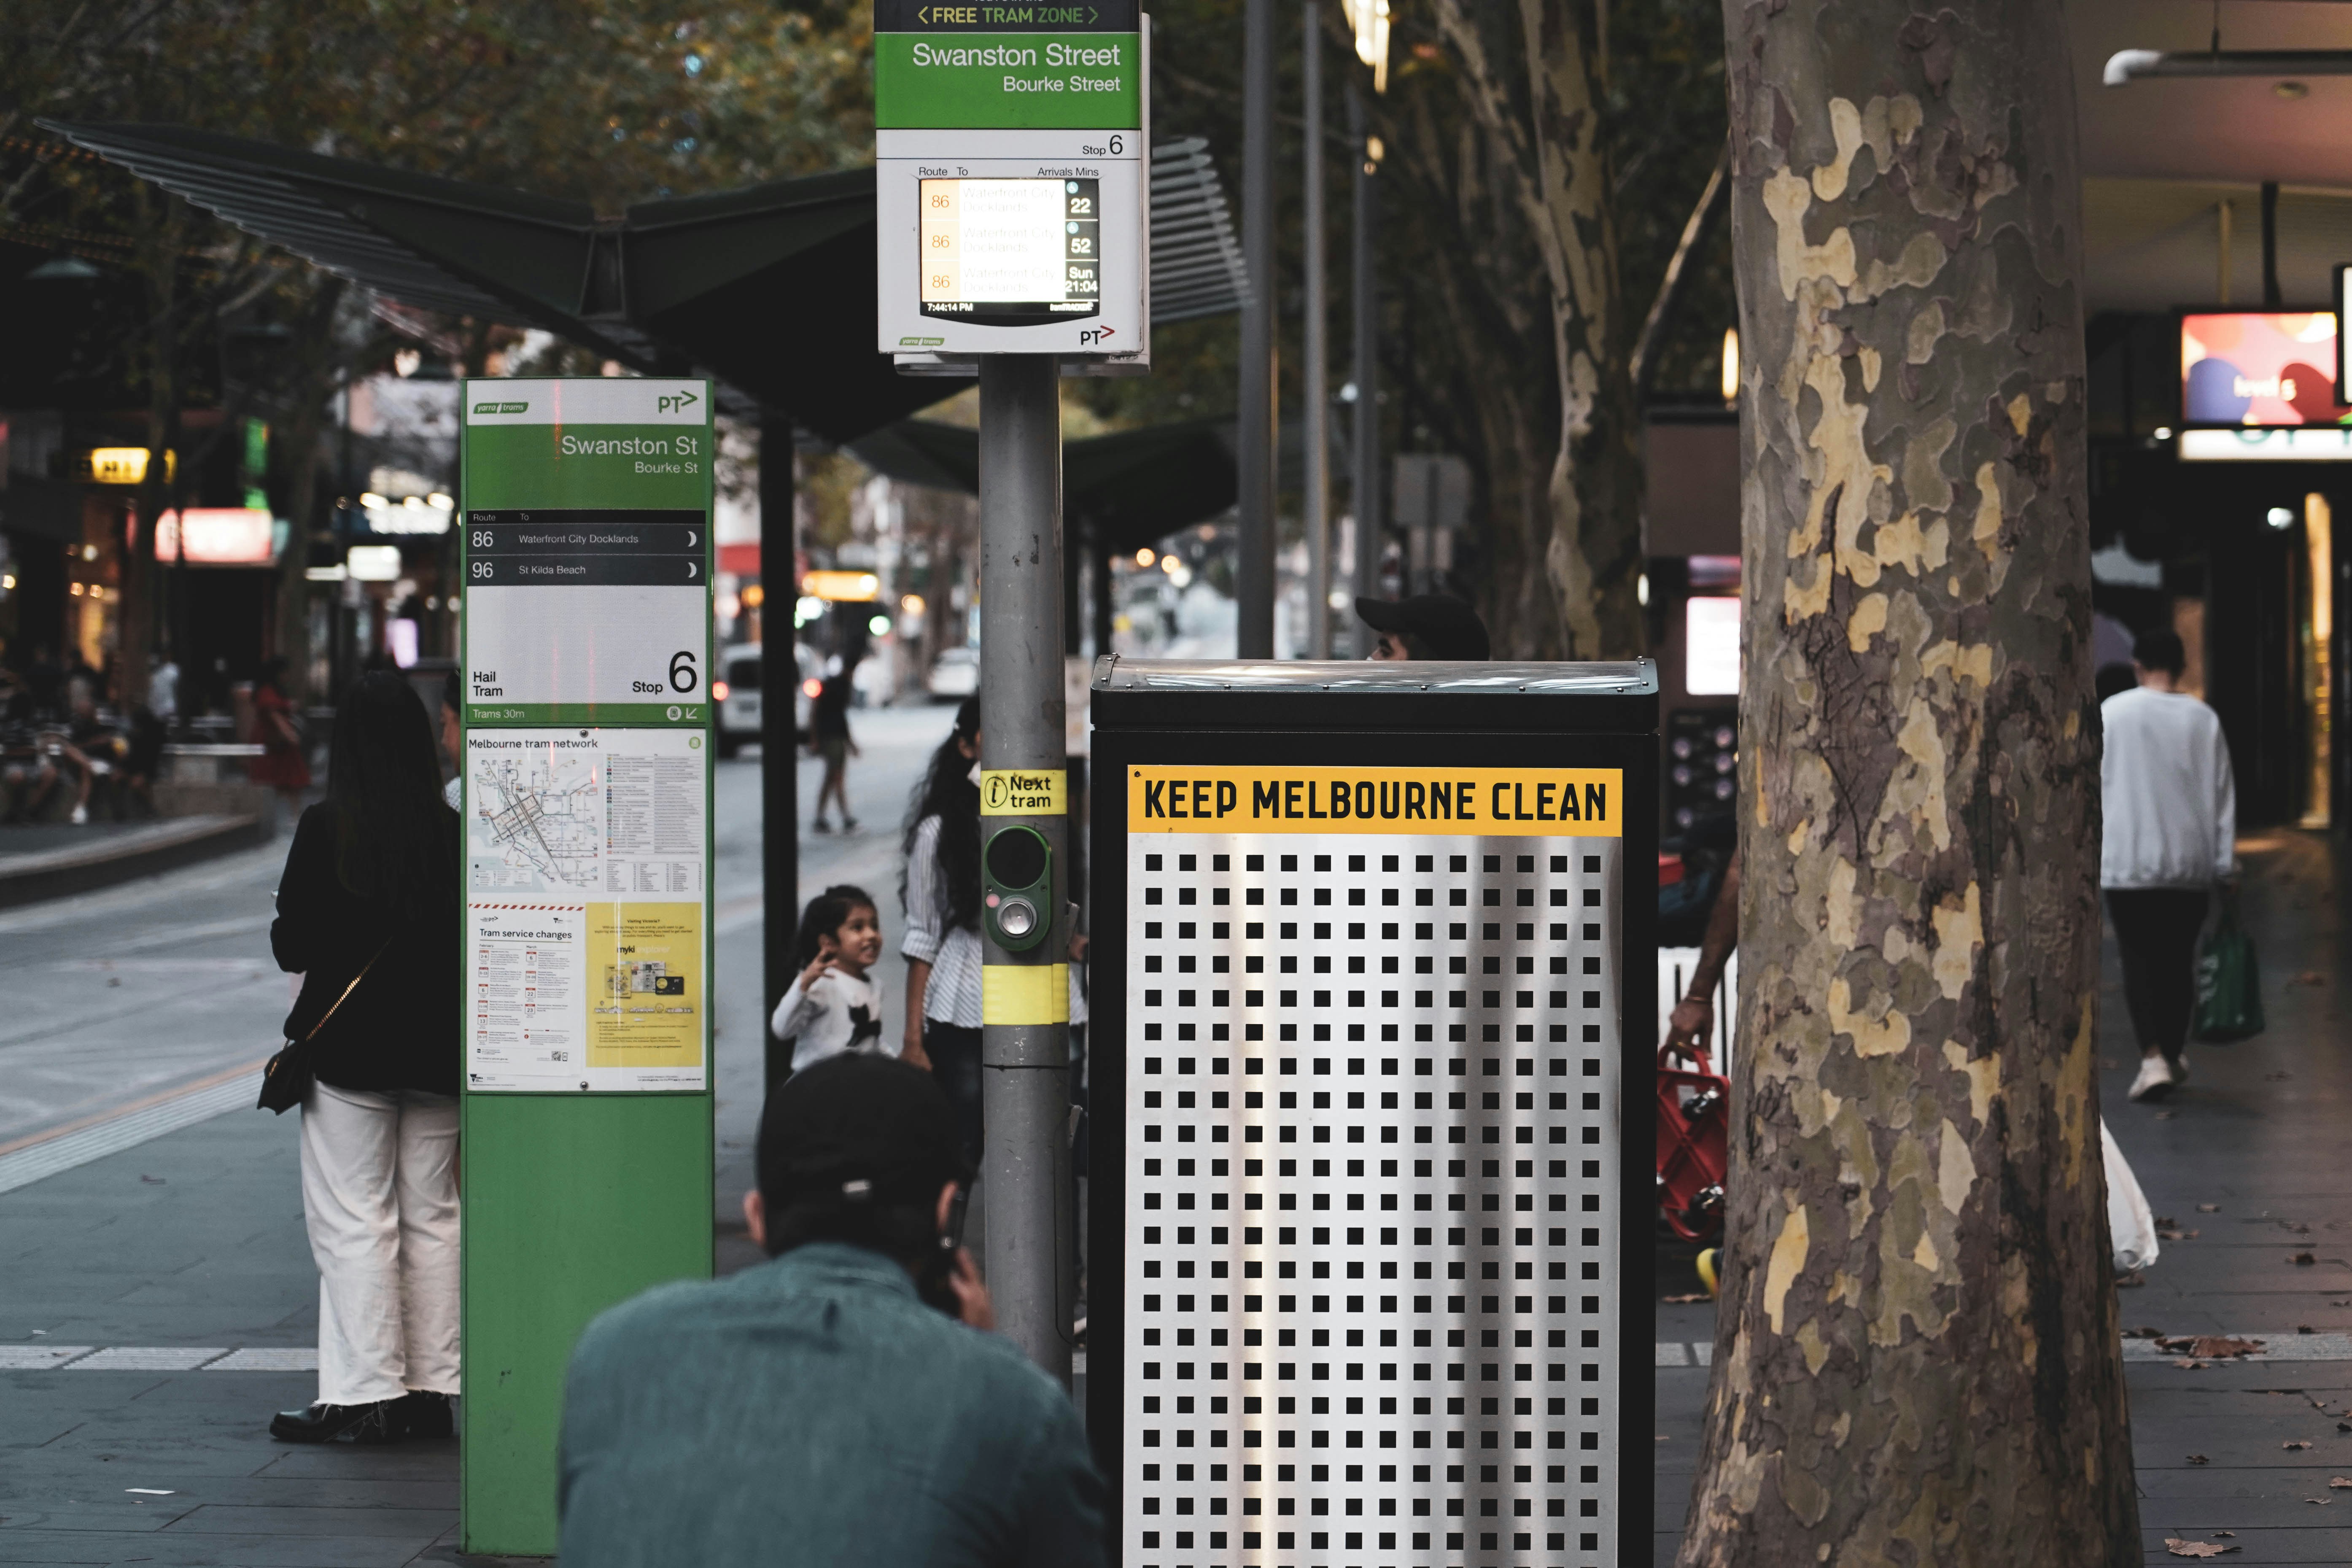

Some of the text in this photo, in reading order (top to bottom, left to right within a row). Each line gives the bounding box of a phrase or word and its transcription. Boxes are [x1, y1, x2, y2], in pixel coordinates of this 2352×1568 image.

[933, 7, 1083, 23] FREE TRAM ZONE
[913, 43, 1120, 66] Swanston Street
[1004, 76, 1120, 92] Bourke Street
[1083, 135, 1123, 156] Stop 6
[919, 167, 968, 175] Route To
[1038, 167, 1099, 176] Arrivals Mins
[963, 188, 1054, 200] Waterfront City
[932, 195, 949, 207] 86
[963, 202, 1028, 211] Docklands
[1071, 198, 1091, 213] 22
[963, 228, 1054, 240] Waterfront City
[932, 235, 949, 248] 86
[964, 242, 1028, 252] Docklands
[1071, 238, 1091, 253] 52
[963, 268, 1054, 281] Waterfront City
[1070, 267, 1093, 279] Sun
[932, 275, 950, 288] 86
[964, 283, 1028, 292] Docklands
[1065, 281, 1097, 292] 21:04
[927, 303, 973, 311] 7:44:14 PM
[477, 404, 496, 412] yarra
[562, 436, 698, 455] Swanston St
[635, 461, 698, 473] Bourke St
[473, 531, 493, 547] 86
[519, 535, 638, 544] Waterfront City Docklands
[473, 562, 493, 578] 96
[519, 566, 585, 574] St Kilda Beach
[474, 671, 496, 682] Hail
[633, 651, 697, 695] Stop 6
[473, 686, 502, 696] Tram
[473, 709, 524, 718] Trams 30m
[469, 739, 522, 748] Melbourne
[554, 739, 598, 748] network
[1011, 776, 1051, 790] Next
[1010, 795, 1051, 807] tram
[1145, 781, 1606, 821] KEEP MELBOURNE CLEAN
[503, 929, 533, 938] service
[536, 930, 571, 940] changes
[617, 945, 635, 955] myki
